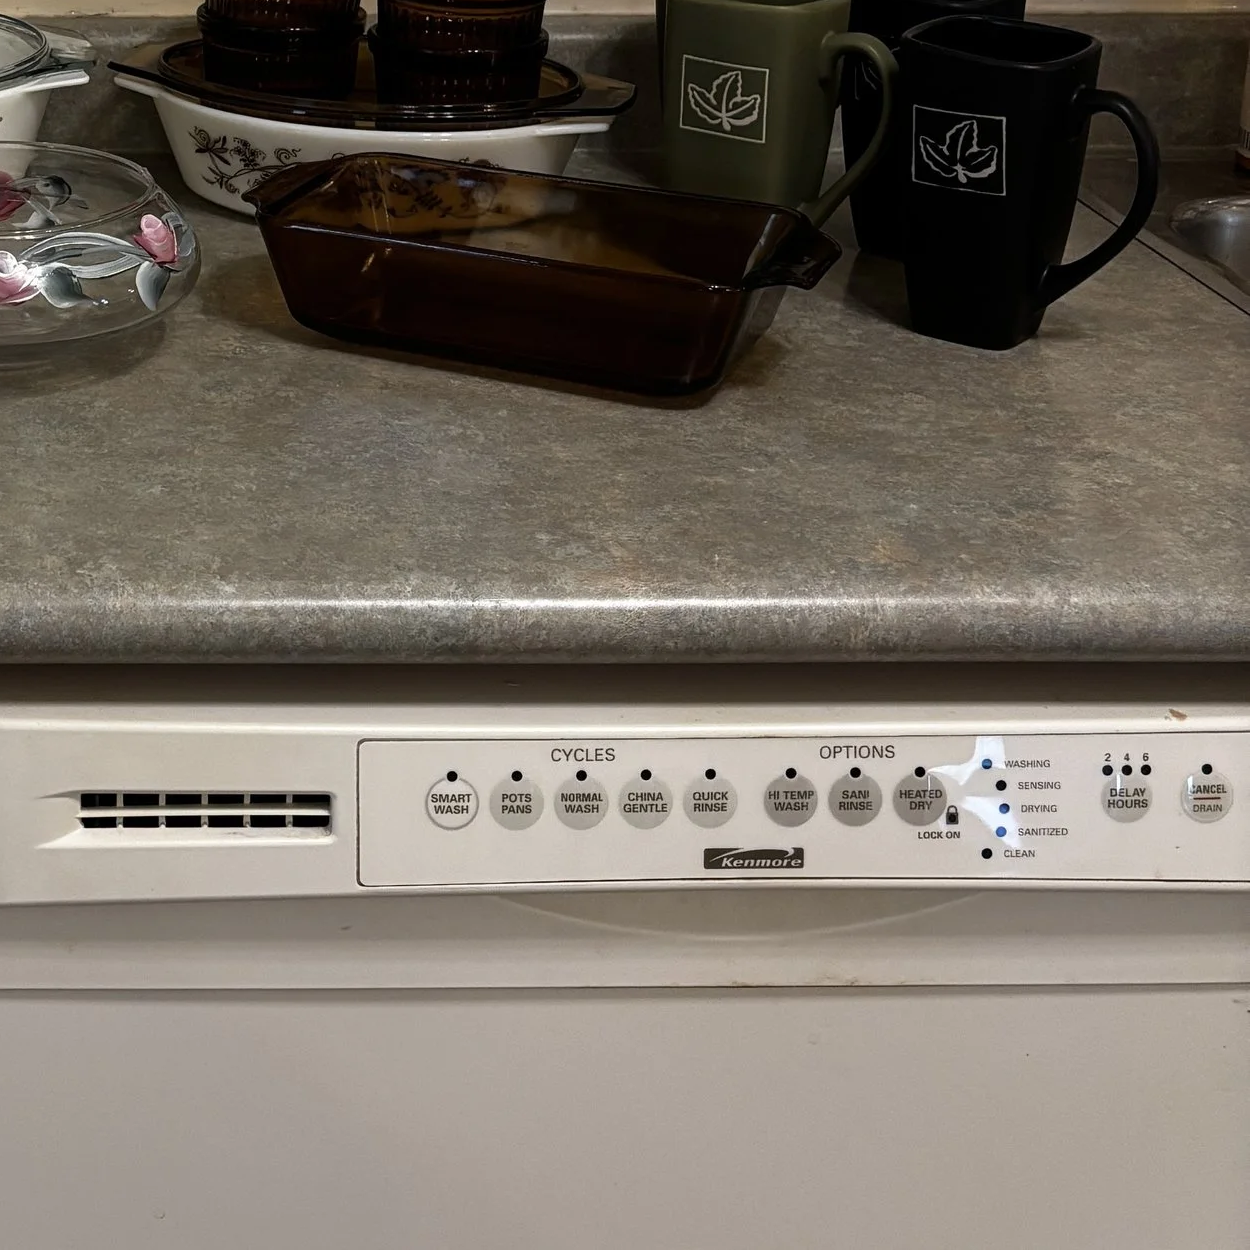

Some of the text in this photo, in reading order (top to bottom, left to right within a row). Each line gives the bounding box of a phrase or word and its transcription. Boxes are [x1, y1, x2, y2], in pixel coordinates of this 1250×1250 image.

[551, 748, 616, 762] CYCLES
[819, 745, 896, 760] OPTIONS
[1104, 752, 1149, 762] 2 4 6
[1004, 760, 1051, 768] WASHING
[1017, 781, 1061, 790] SENSING
[1190, 784, 1227, 794] CANCEL
[627, 792, 664, 802] CHINA
[693, 791, 729, 802] QUICK
[768, 790, 814, 801] HI TEMP
[841, 789, 870, 800] SANI
[899, 789, 943, 799] HEATED
[1110, 787, 1146, 797] DELAY
[431, 793, 472, 804] SMART
[501, 793, 532, 803] POTS
[560, 792, 604, 803] NORMAL
[564, 803, 599, 814] WASH
[623, 802, 668, 813] GENTLE
[693, 802, 728, 812] RINSE
[773, 800, 809, 811] WASH
[838, 799, 873, 811] RINSE
[909, 800, 933, 810] DRY
[1021, 804, 1057, 813] DRYING
[1107, 799, 1148, 809] HOURS
[1193, 804, 1223, 813] DRAIN
[434, 804, 469, 815] WASH
[501, 804, 532, 815] PANS
[918, 831, 961, 839] LOCK ON
[1017, 827, 1068, 836] SANITIZED
[1003, 849, 1035, 858] CLEAN
[721, 855, 802, 868] Kenmore
